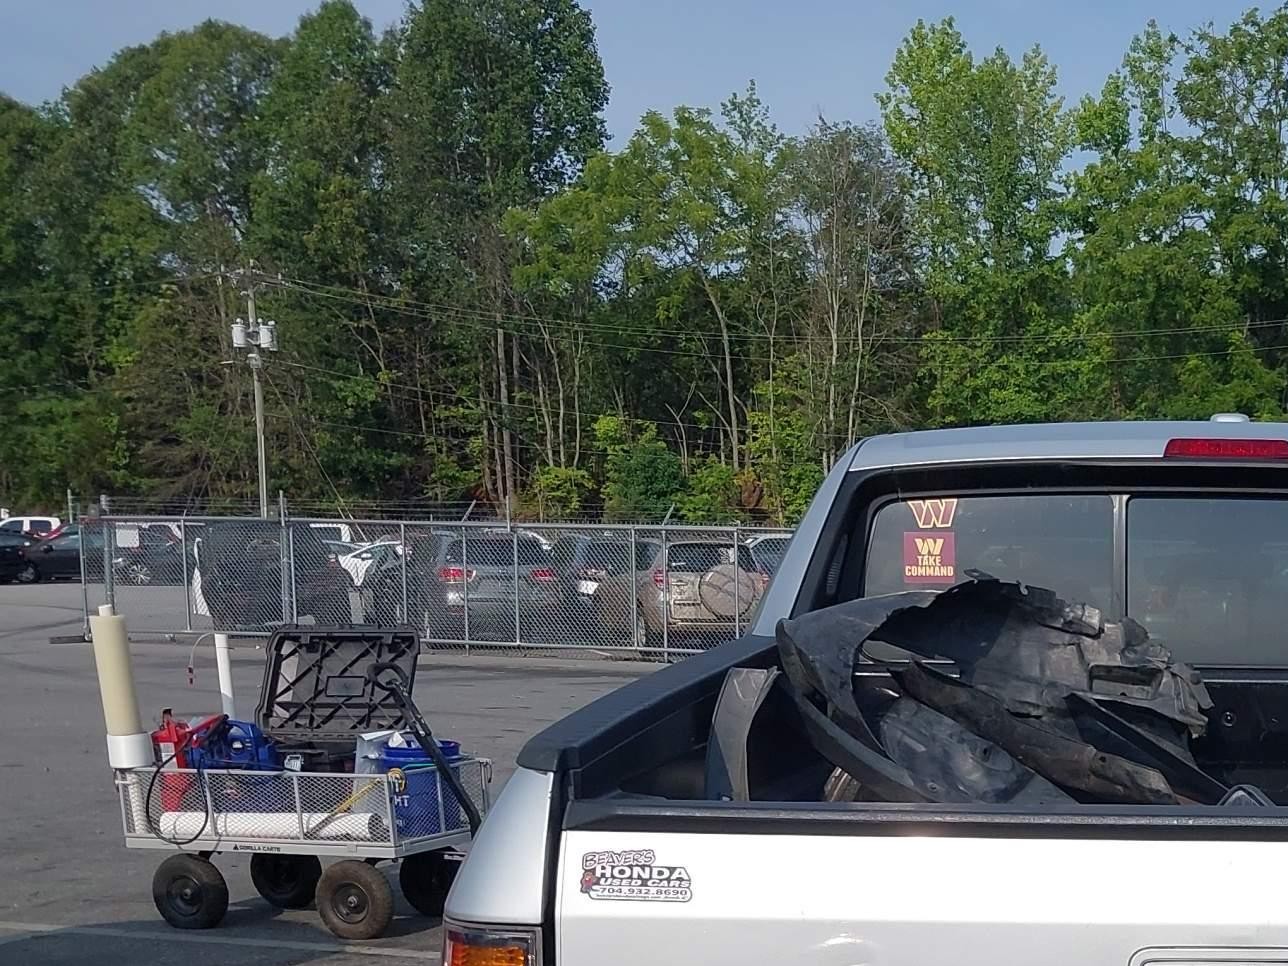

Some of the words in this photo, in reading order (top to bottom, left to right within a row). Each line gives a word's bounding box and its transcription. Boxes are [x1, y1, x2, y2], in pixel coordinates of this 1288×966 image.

[917, 556, 941, 566] TAKE
[905, 566, 954, 576] COMMAND
[584, 850, 654, 870] BEAVER'S
[595, 865, 689, 880] HONDA
[599, 878, 642, 886] USED
[647, 879, 690, 888] CARS
[600, 887, 688, 896] 704.932.8690
